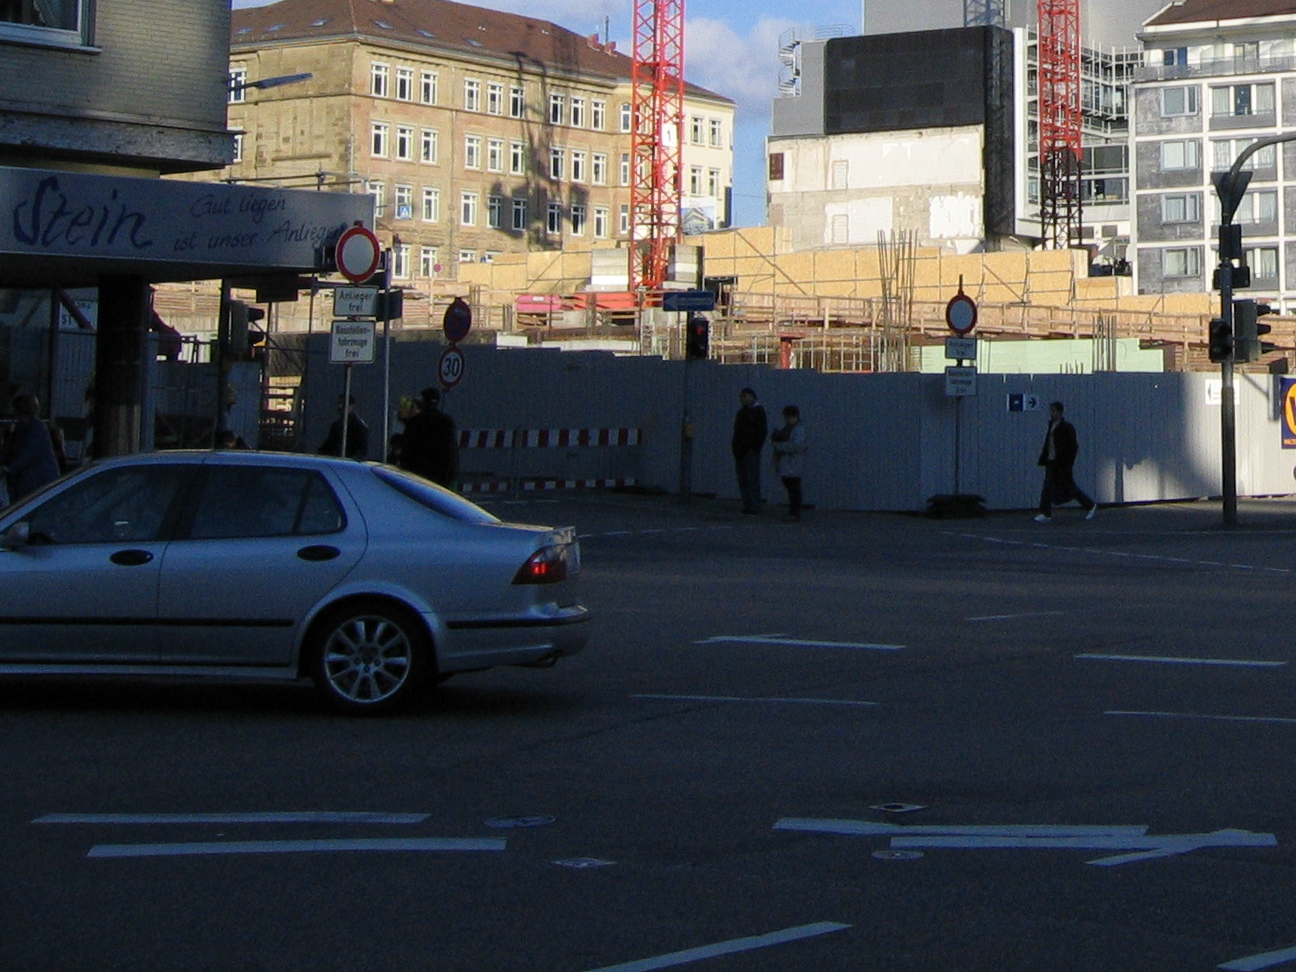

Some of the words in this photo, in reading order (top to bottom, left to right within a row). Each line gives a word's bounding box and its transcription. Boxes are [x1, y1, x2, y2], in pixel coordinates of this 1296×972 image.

[12, 175, 154, 249] Stein
[191, 194, 231, 218] Gut
[239, 193, 286, 224] liegen
[173, 232, 198, 252] ist
[208, 231, 258, 248] unser
[338, 290, 375, 302] Anlieger
[348, 302, 363, 312] frei
[443, 357, 460, 376] 30
